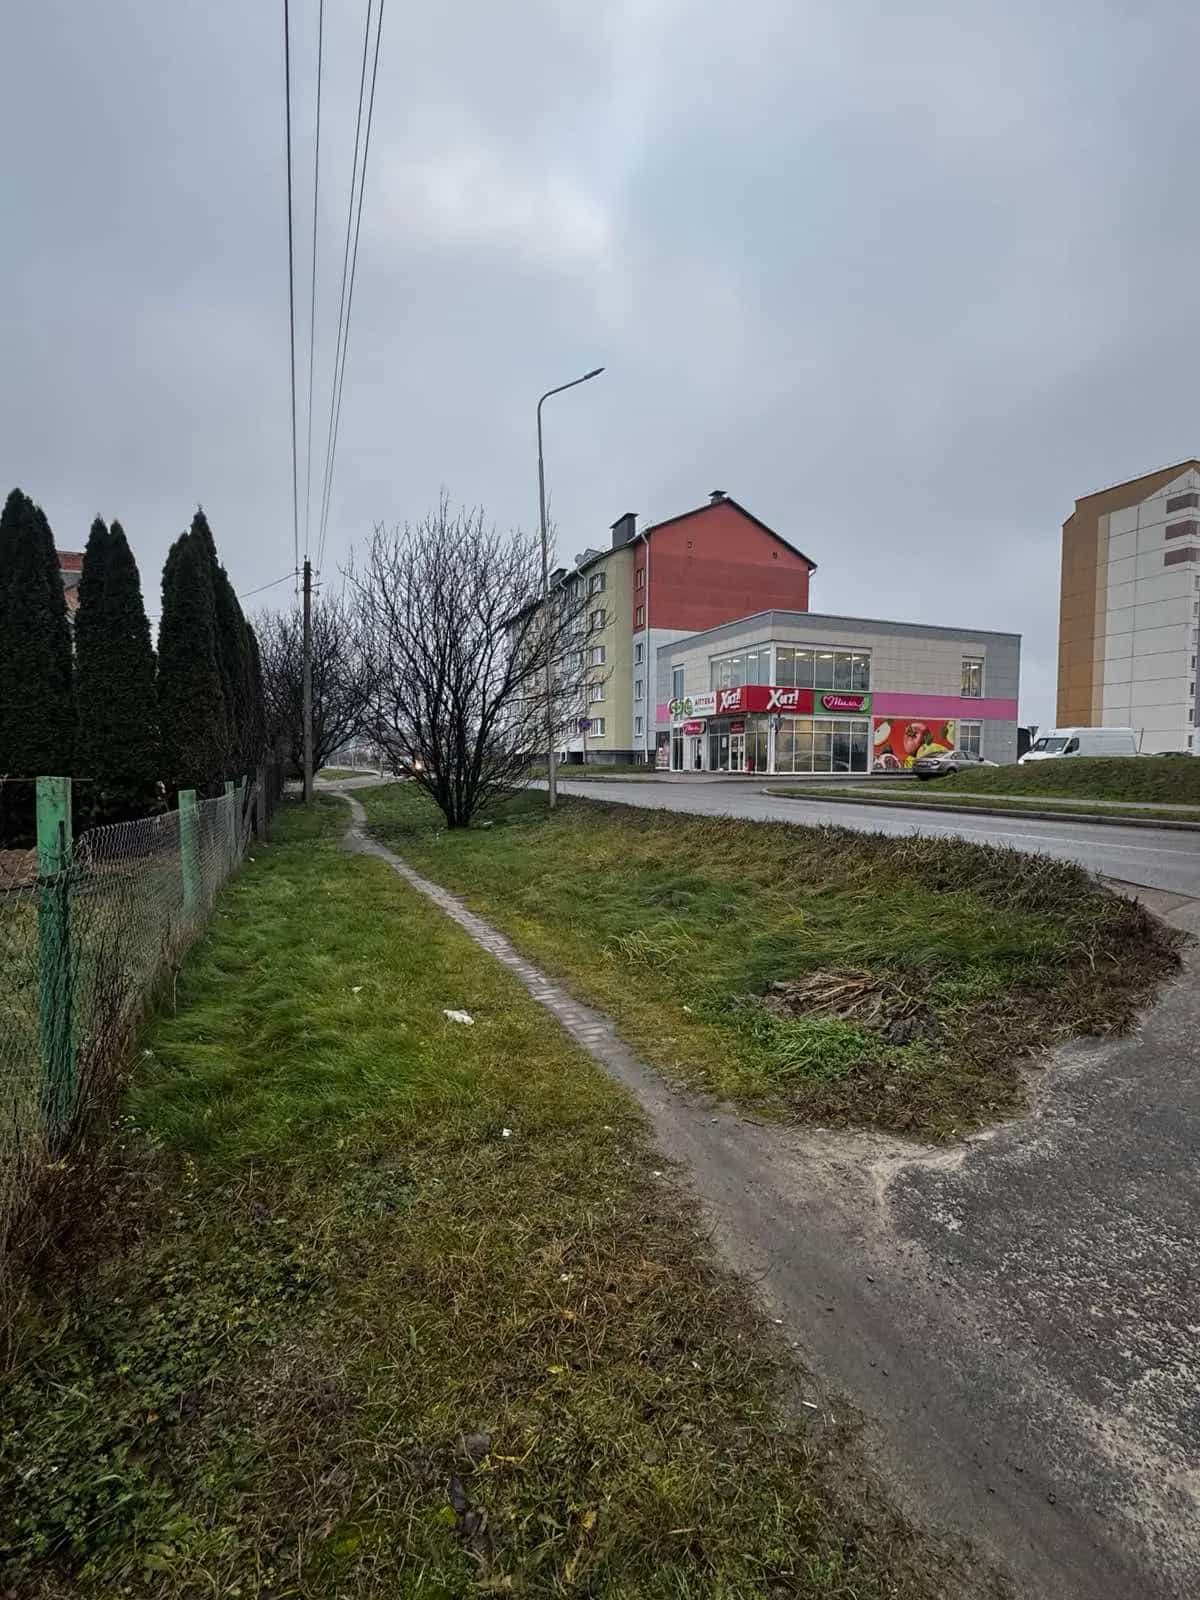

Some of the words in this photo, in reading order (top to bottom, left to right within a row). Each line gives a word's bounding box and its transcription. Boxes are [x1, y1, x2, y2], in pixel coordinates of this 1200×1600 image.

[695, 696, 714, 706] АПТЕКА
[719, 688, 741, 711] Хит!
[766, 688, 799, 711] Хит!
